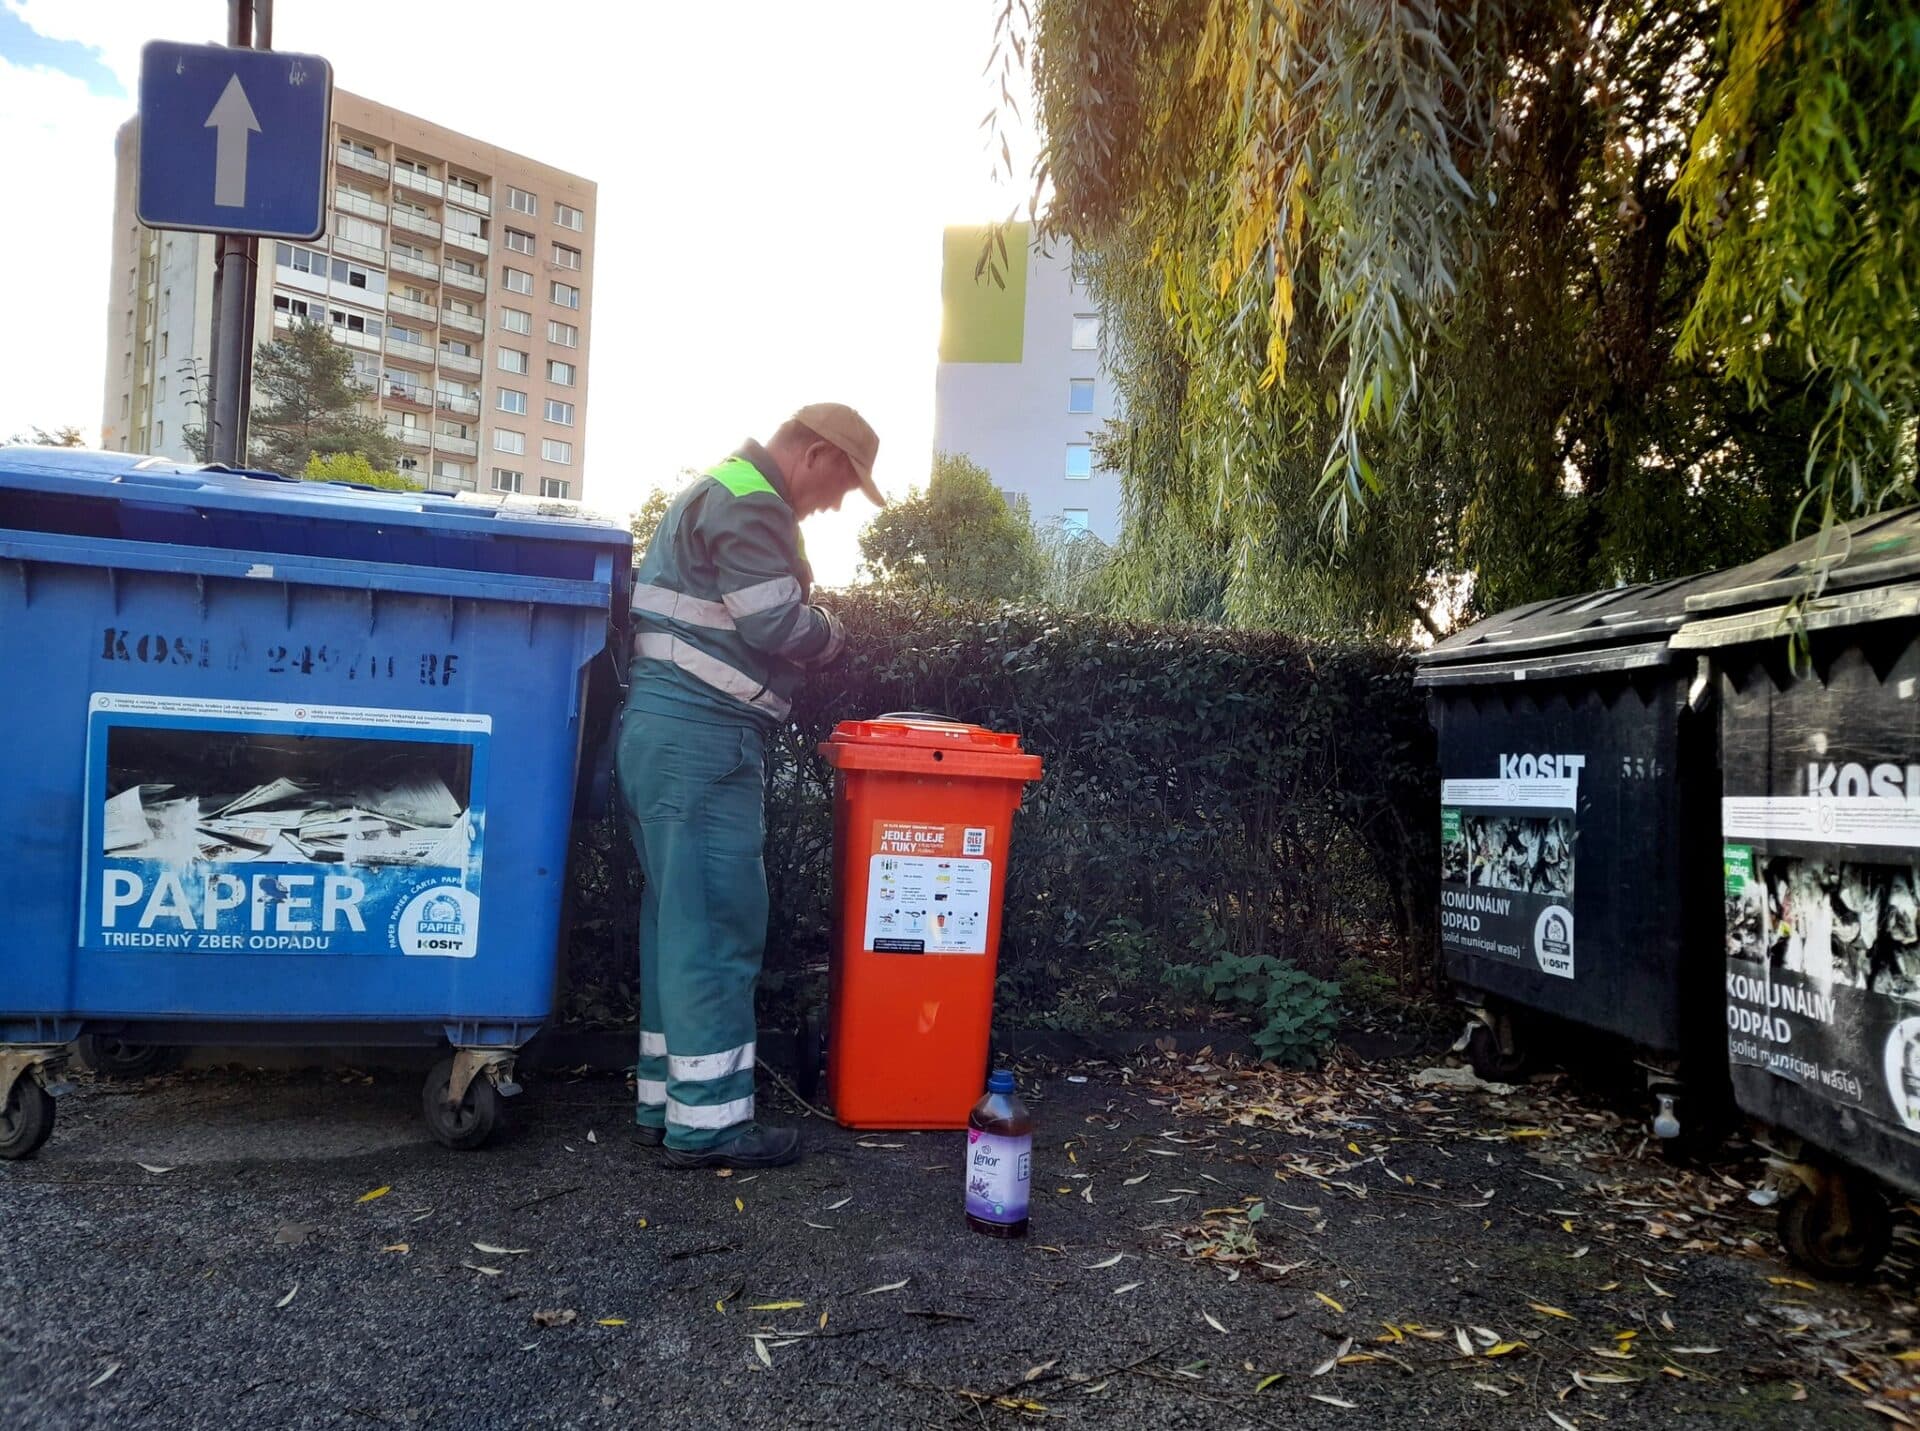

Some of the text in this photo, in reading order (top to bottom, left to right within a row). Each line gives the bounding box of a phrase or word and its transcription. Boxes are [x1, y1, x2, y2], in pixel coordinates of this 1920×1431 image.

[1500, 753, 1585, 779] KOSIT
[881, 830, 944, 843] JEDLÉ OLEJE
[881, 842, 888, 851] A
[891, 843, 917, 852] TUKY
[101, 869, 366, 932] PAPIER
[390, 894, 409, 920] PAPIER
[410, 878, 437, 894] CARTA
[1441, 890, 1511, 916] KOMUNÁLNY
[420, 922, 462, 934] PAPIER
[1441, 911, 1481, 932] ODPAD
[101, 931, 330, 950] TRIEDENÝ ZBER ODPADU
[417, 939, 463, 950] KOSIT
[1460, 936, 1497, 953] municipal
[1497, 943, 1521, 960] waste)
[1727, 972, 1836, 1025] KOMUNÁLNY
[1728, 1005, 1792, 1043] ODPAD
[1760, 1050, 1818, 1081] municipal
[1820, 1068, 1862, 1101] waste)
[973, 1150, 1000, 1167] Lenor
